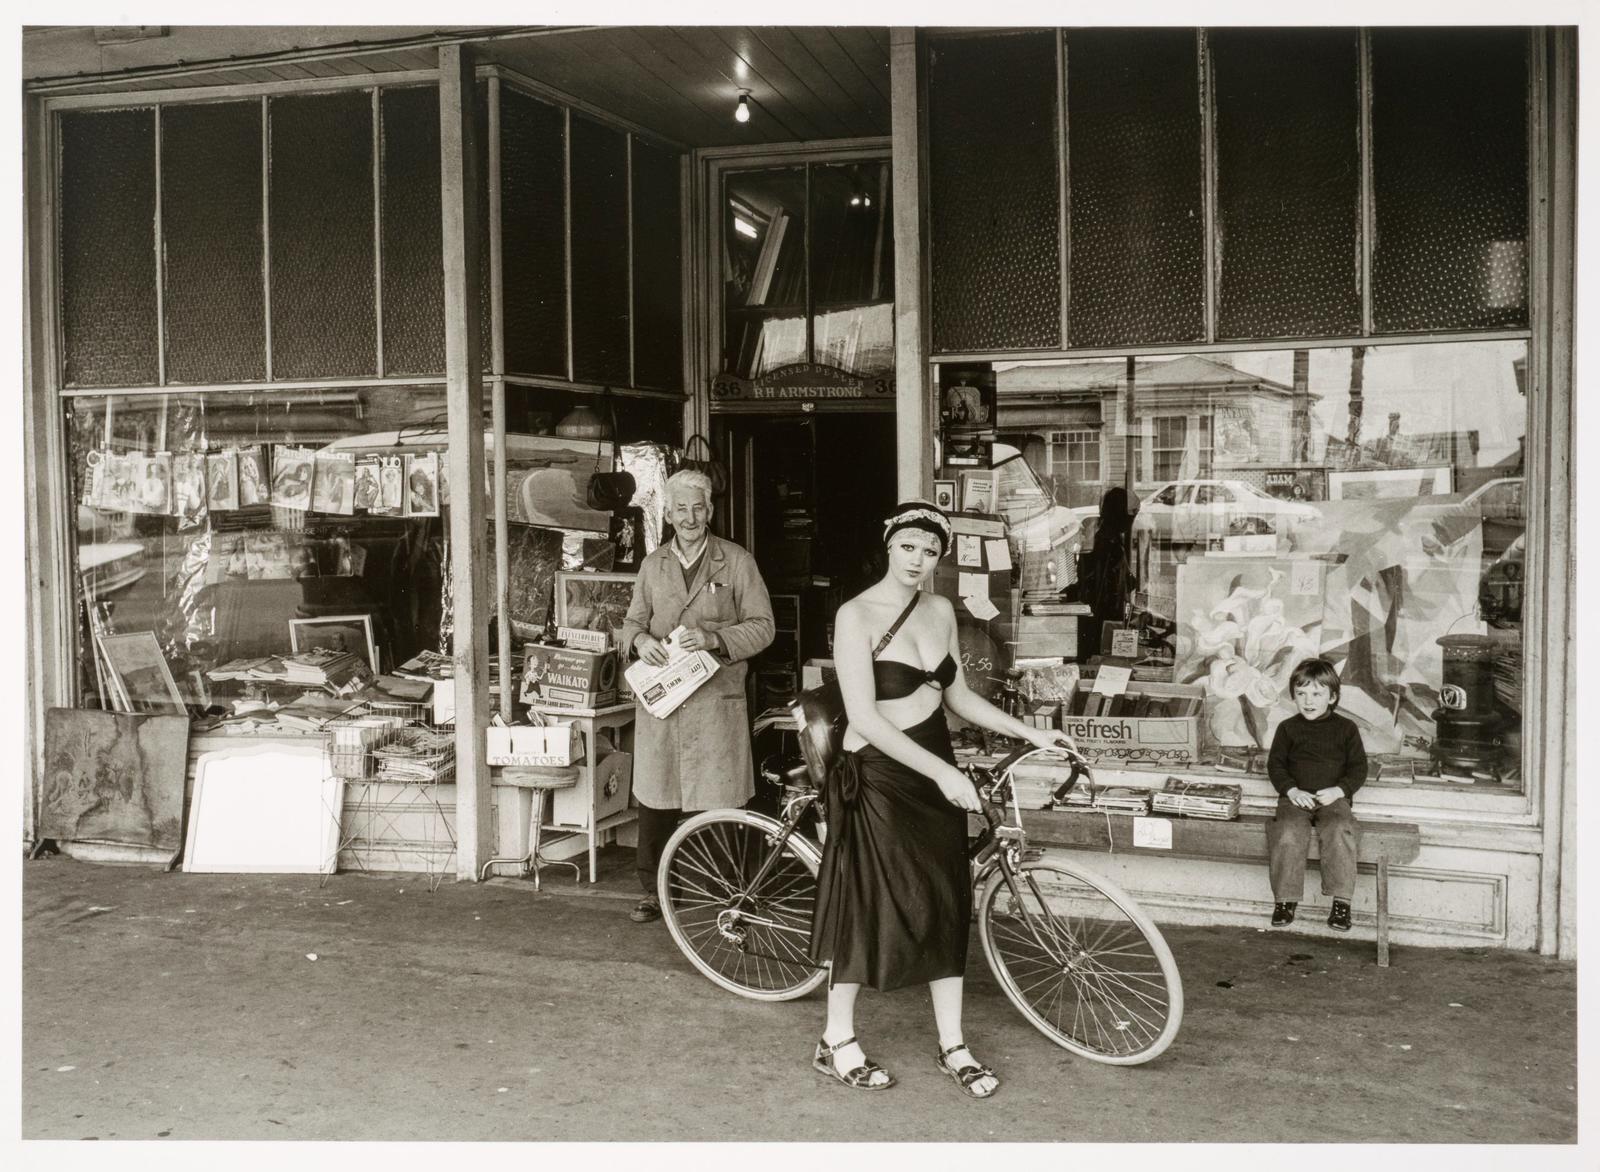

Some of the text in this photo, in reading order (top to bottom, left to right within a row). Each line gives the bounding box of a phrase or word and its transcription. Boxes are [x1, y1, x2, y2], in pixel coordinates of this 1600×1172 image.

[753, 365, 864, 388] LICENSED DEALER
[716, 382, 741, 396] 36
[780, 387, 862, 398] ARMSTRONG
[547, 672, 589, 689] WAIKATO
[666, 677, 682, 690] NEWS
[1067, 718, 1132, 739] refresh
[492, 755, 565, 767] TOMATOES
